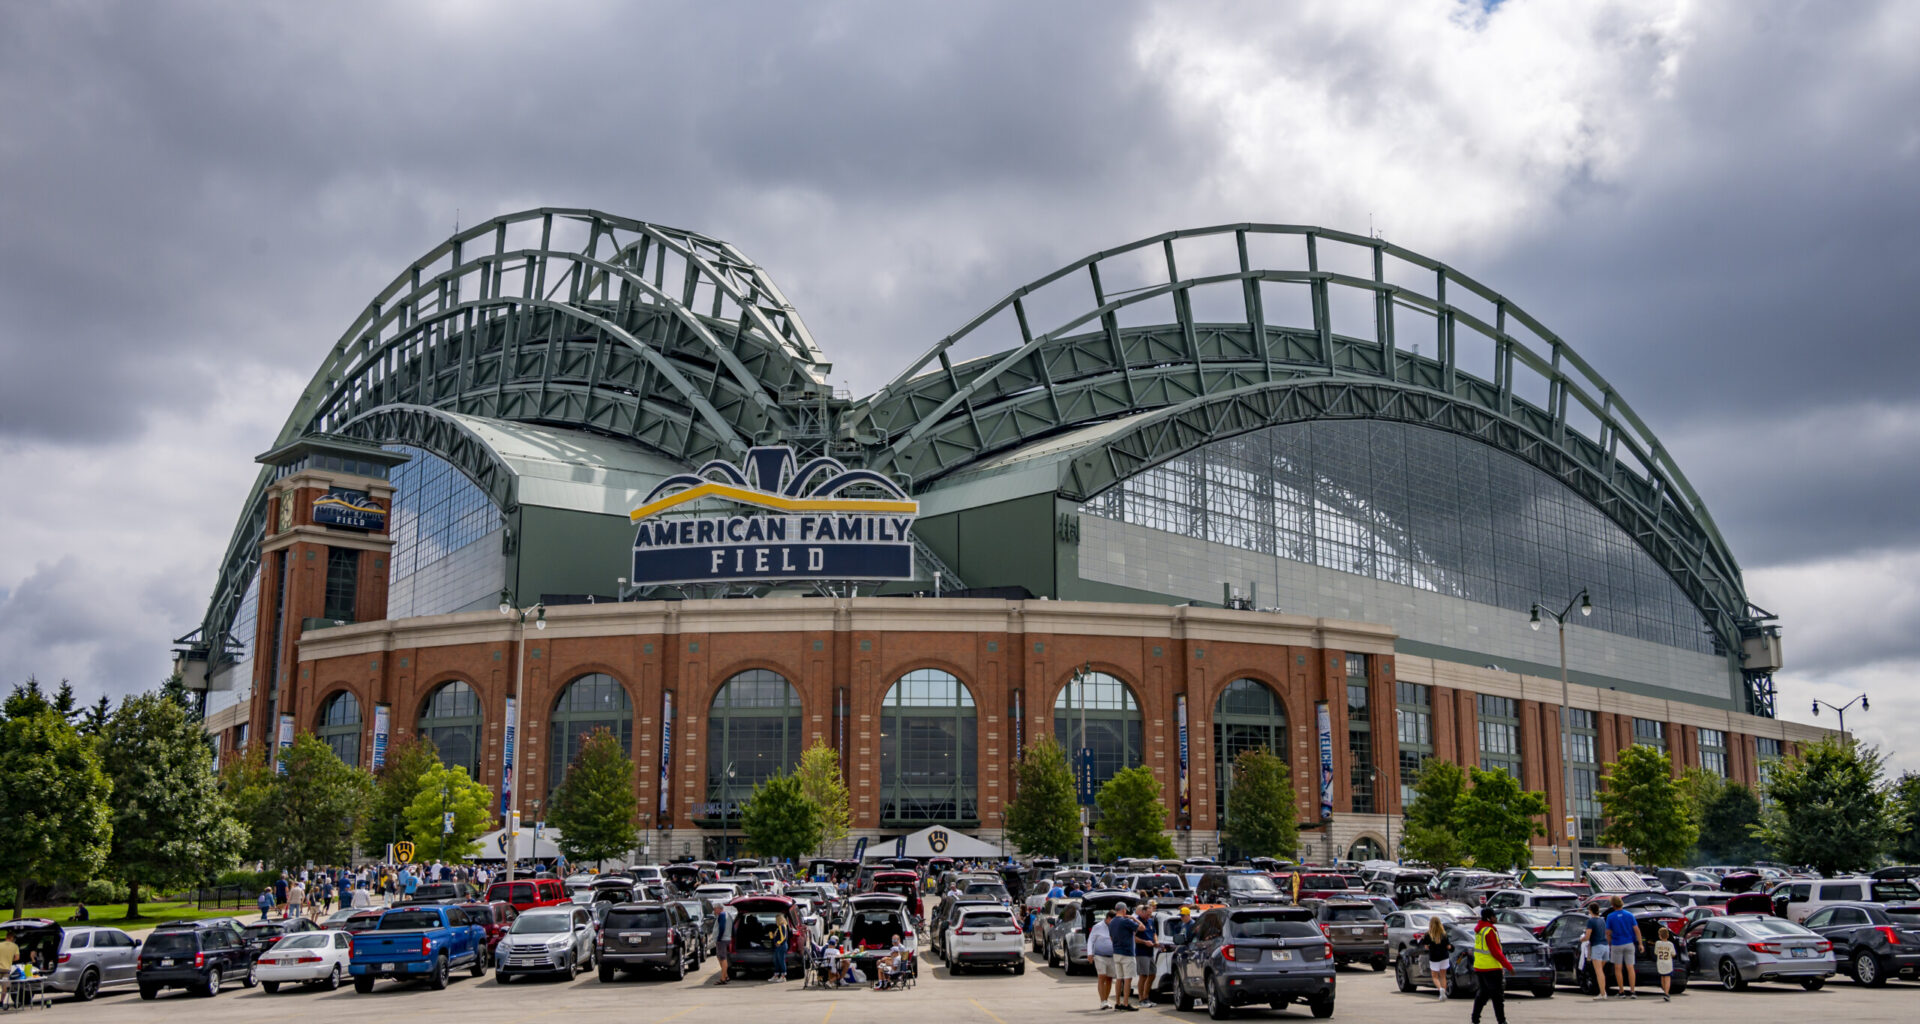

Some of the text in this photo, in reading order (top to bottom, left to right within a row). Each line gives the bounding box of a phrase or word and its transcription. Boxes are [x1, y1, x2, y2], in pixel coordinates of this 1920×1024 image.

[336, 516, 365, 526] FIELD
[635, 517, 912, 547] AMERICAN FAMILY
[711, 548, 824, 573] FIELD
[1320, 731, 1331, 766] YELICH
[1658, 950, 1669, 960] 22
